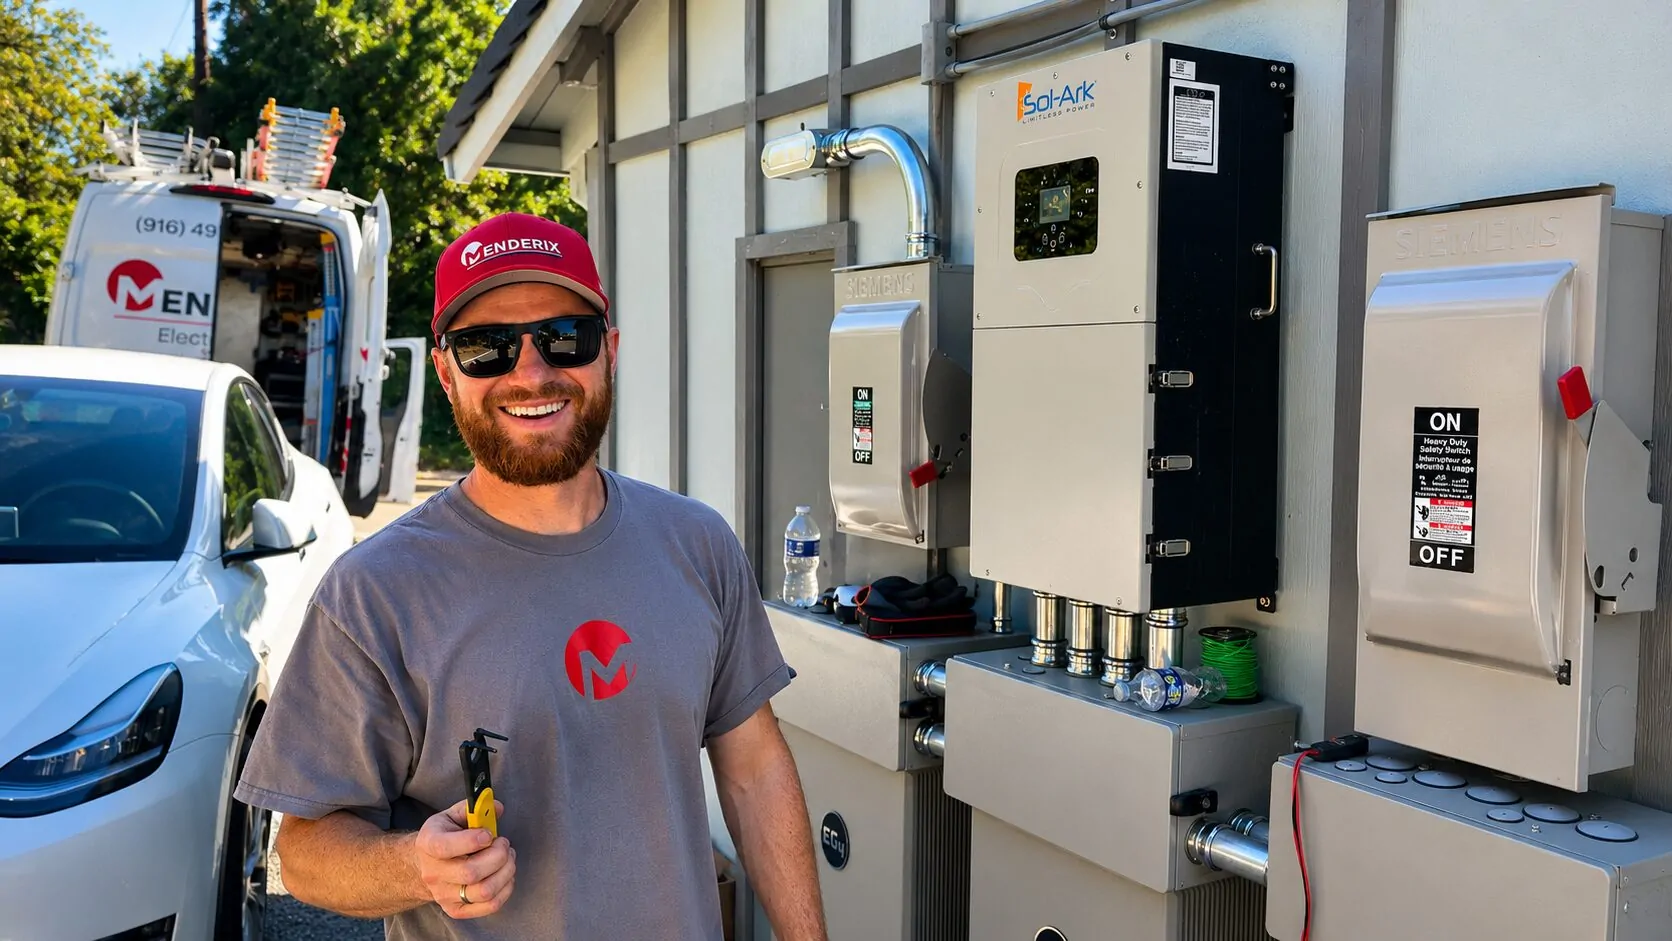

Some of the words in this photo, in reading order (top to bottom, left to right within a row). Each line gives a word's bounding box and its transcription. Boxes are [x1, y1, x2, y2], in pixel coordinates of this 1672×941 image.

[1023, 80, 1095, 116] Sol-Ark
[1066, 102, 1095, 113] POWER
[135, 216, 186, 237] (916)
[190, 223, 217, 238] 49
[1395, 214, 1563, 261] SIEMENS
[846, 272, 915, 299] SIEMENS
[158, 327, 209, 346] Elect
[857, 388, 868, 400] ON
[1429, 412, 1461, 431] ON
[855, 451, 871, 463] OFF
[1419, 545, 1465, 567] OFF
